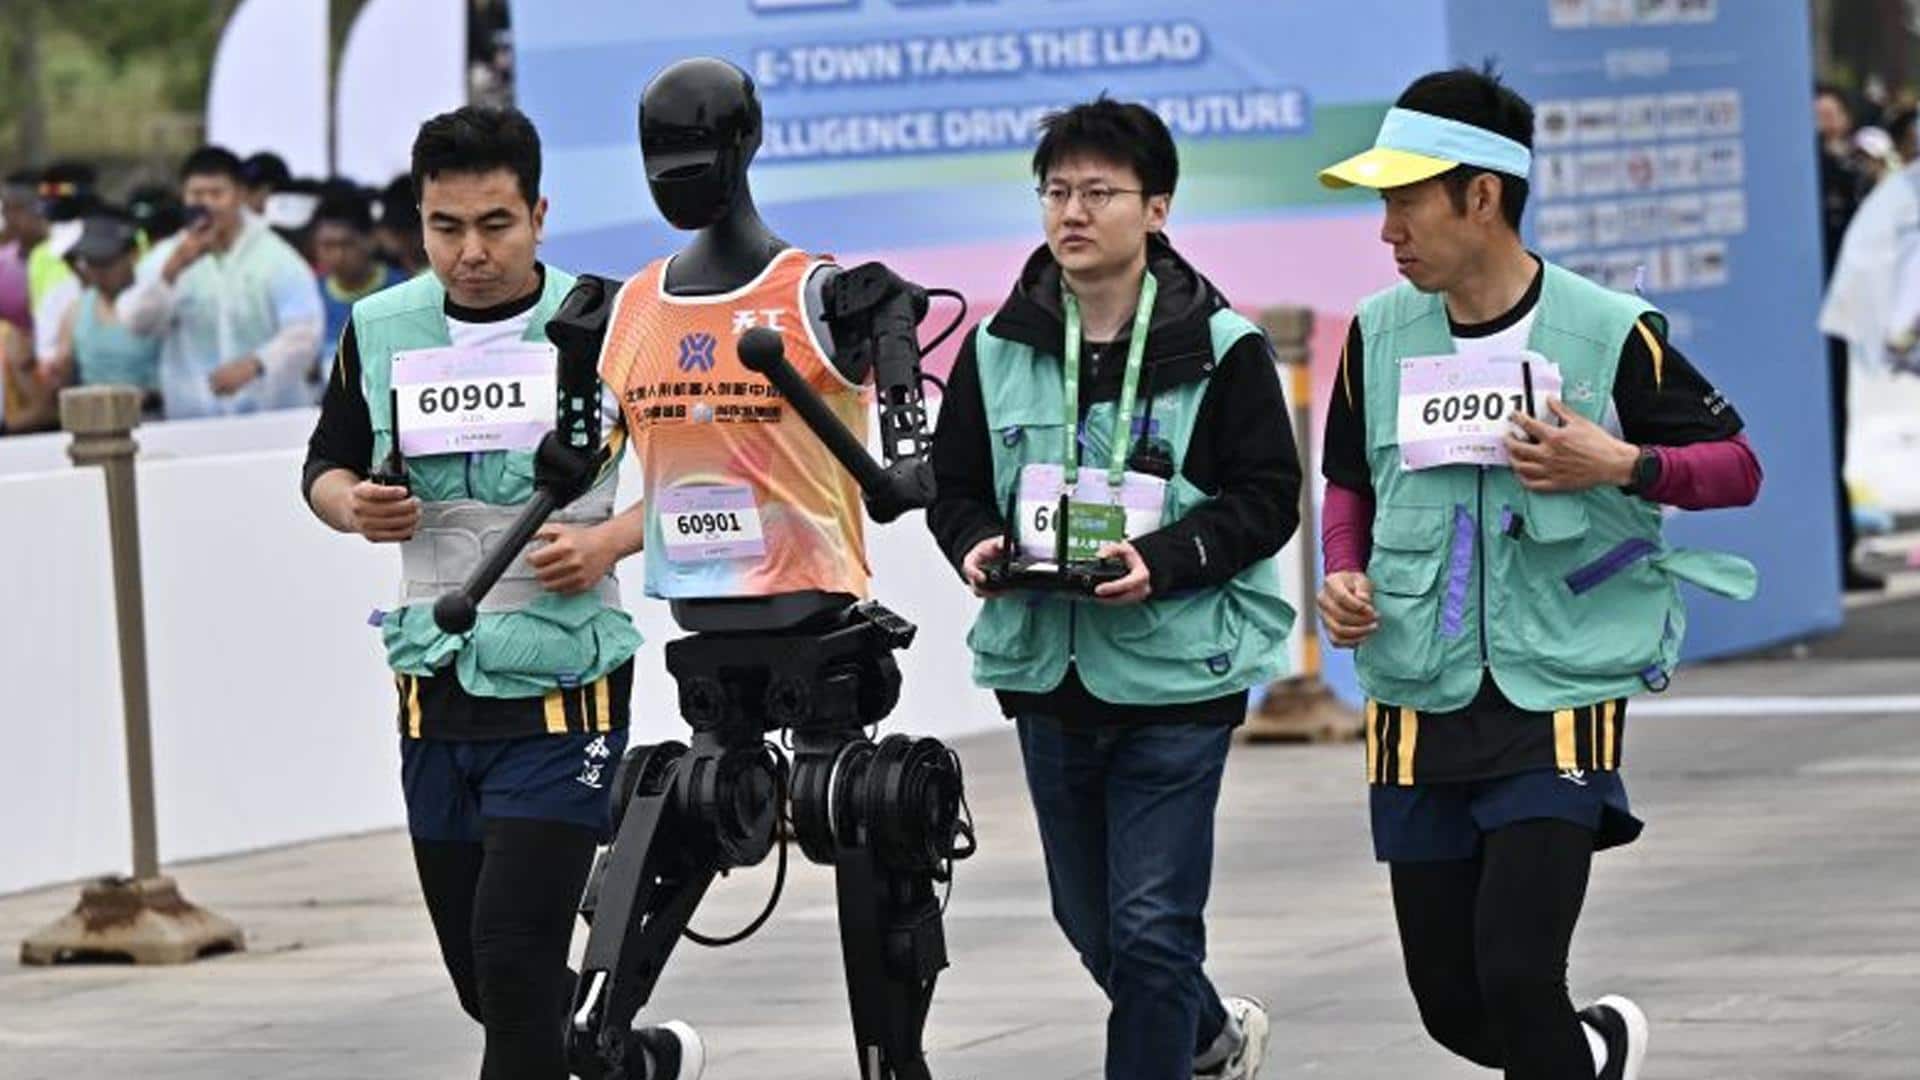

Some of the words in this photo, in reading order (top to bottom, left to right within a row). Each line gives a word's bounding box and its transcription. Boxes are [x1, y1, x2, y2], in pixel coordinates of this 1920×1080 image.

[756, 42, 900, 86] E-TOWN
[907, 33, 1021, 73] TAKES
[1027, 30, 1097, 67] THE
[1102, 23, 1201, 63] LEAD
[418, 381, 526, 415] 60901
[1422, 392, 1524, 425] 60901
[677, 512, 741, 534] 60901
